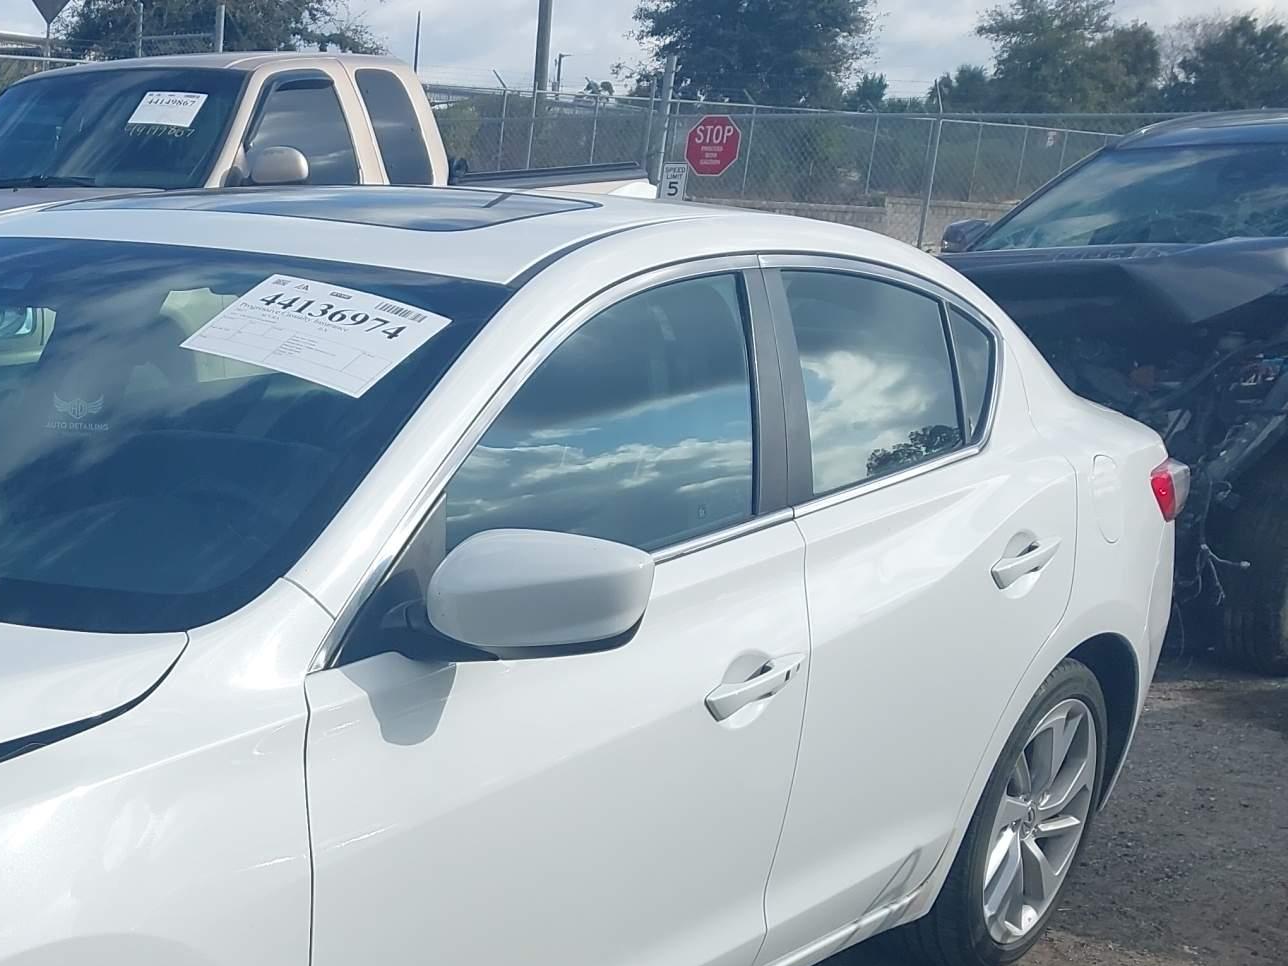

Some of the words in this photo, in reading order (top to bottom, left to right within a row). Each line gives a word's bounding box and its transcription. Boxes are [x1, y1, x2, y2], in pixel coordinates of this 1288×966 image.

[695, 125, 734, 144] STOP
[667, 181, 678, 196] 5
[261, 292, 407, 340] 44136974
